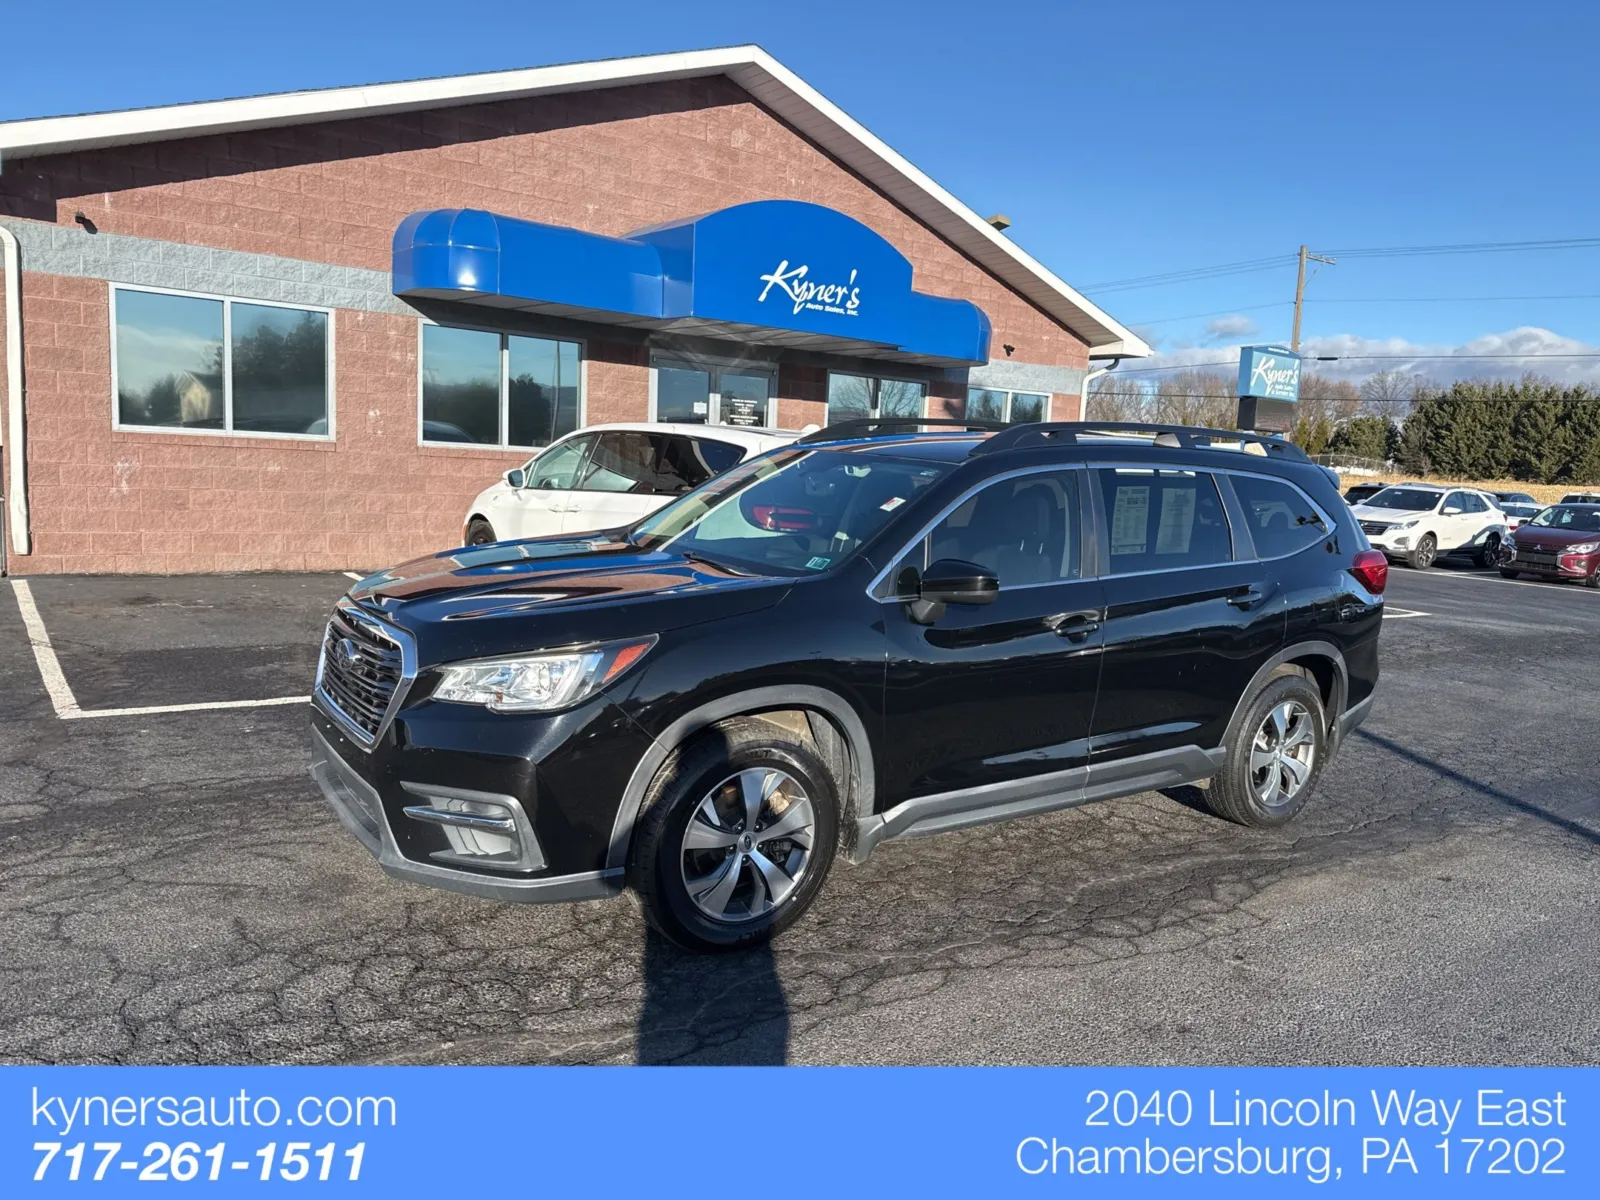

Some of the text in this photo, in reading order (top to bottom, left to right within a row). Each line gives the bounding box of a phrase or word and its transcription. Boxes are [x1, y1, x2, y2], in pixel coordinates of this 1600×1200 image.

[758, 260, 860, 315] Kyner's
[805, 302, 824, 311] Auto
[1250, 356, 1299, 396] Kyner's
